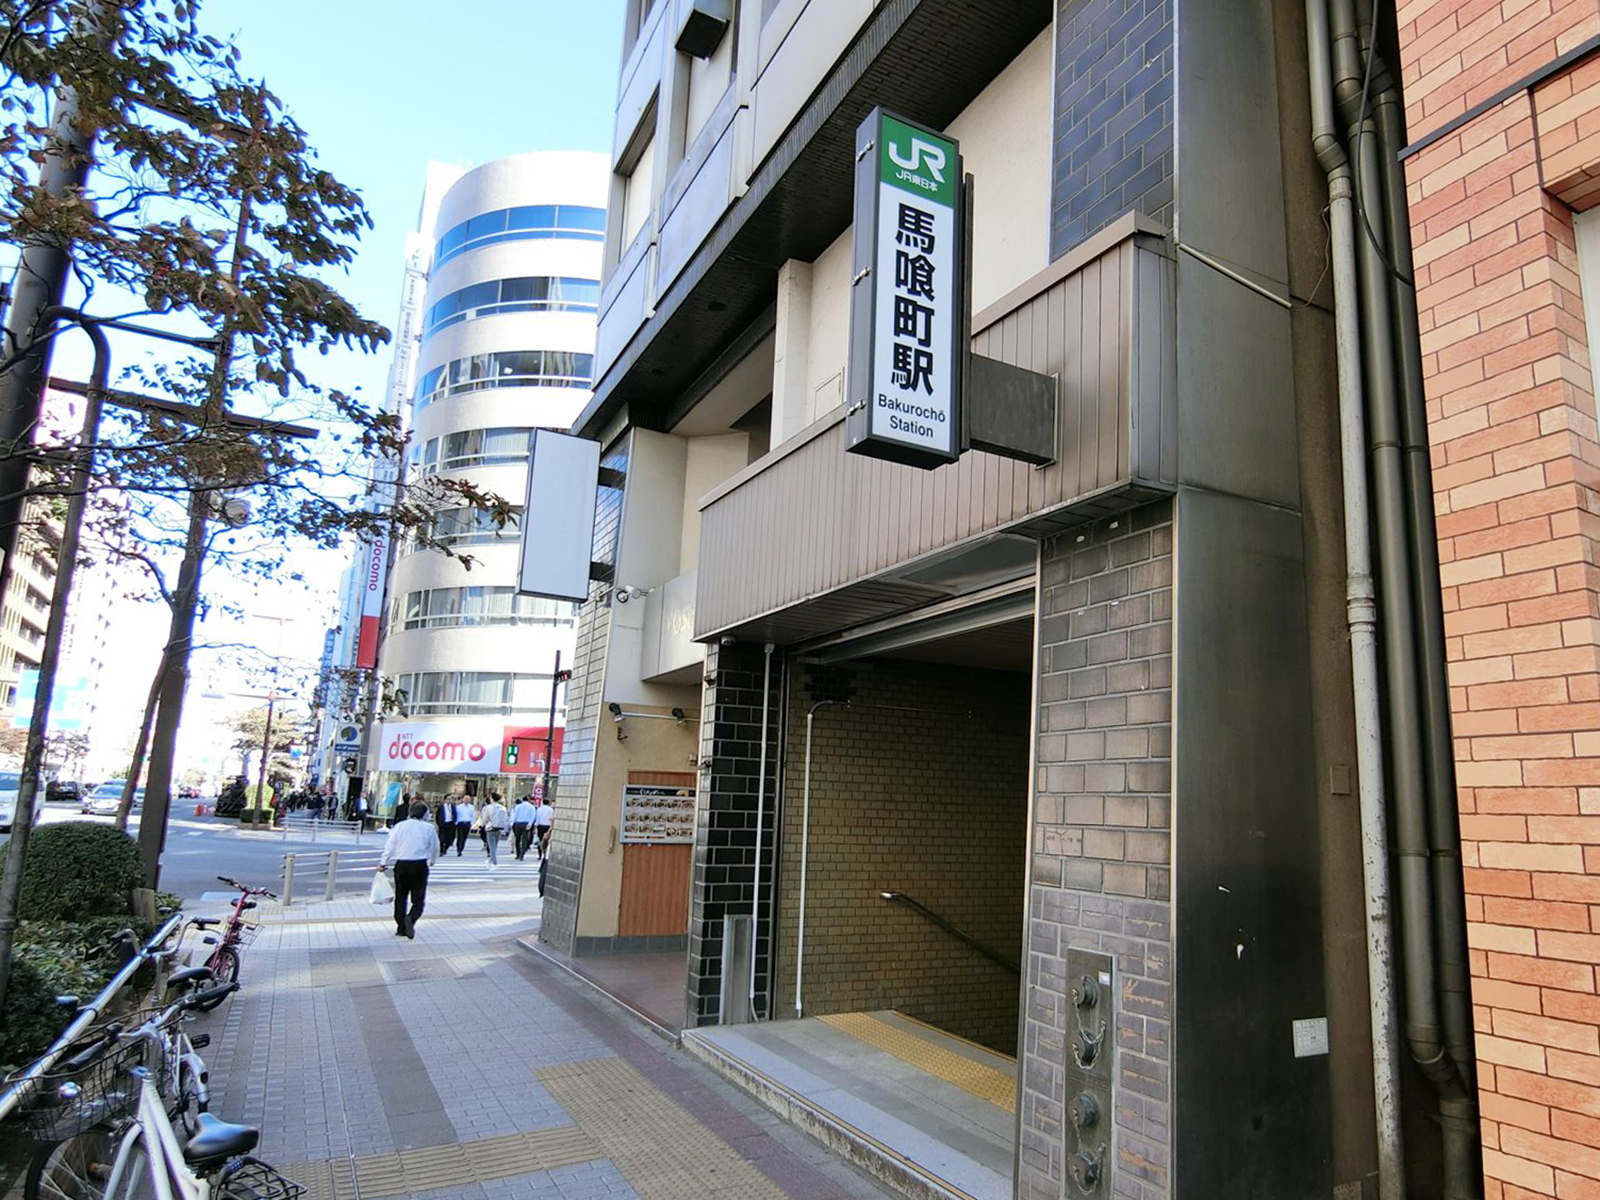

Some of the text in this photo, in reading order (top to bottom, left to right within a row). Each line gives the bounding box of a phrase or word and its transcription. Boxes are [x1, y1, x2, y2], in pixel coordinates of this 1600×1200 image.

[889, 137, 946, 184] JR
[895, 169, 938, 192] JR東日本
[890, 202, 936, 397] 馬喰町駅
[889, 414, 934, 438] Station
[368, 540, 386, 591] docomo
[388, 733, 486, 762] docomo
[401, 732, 414, 740] NTT
